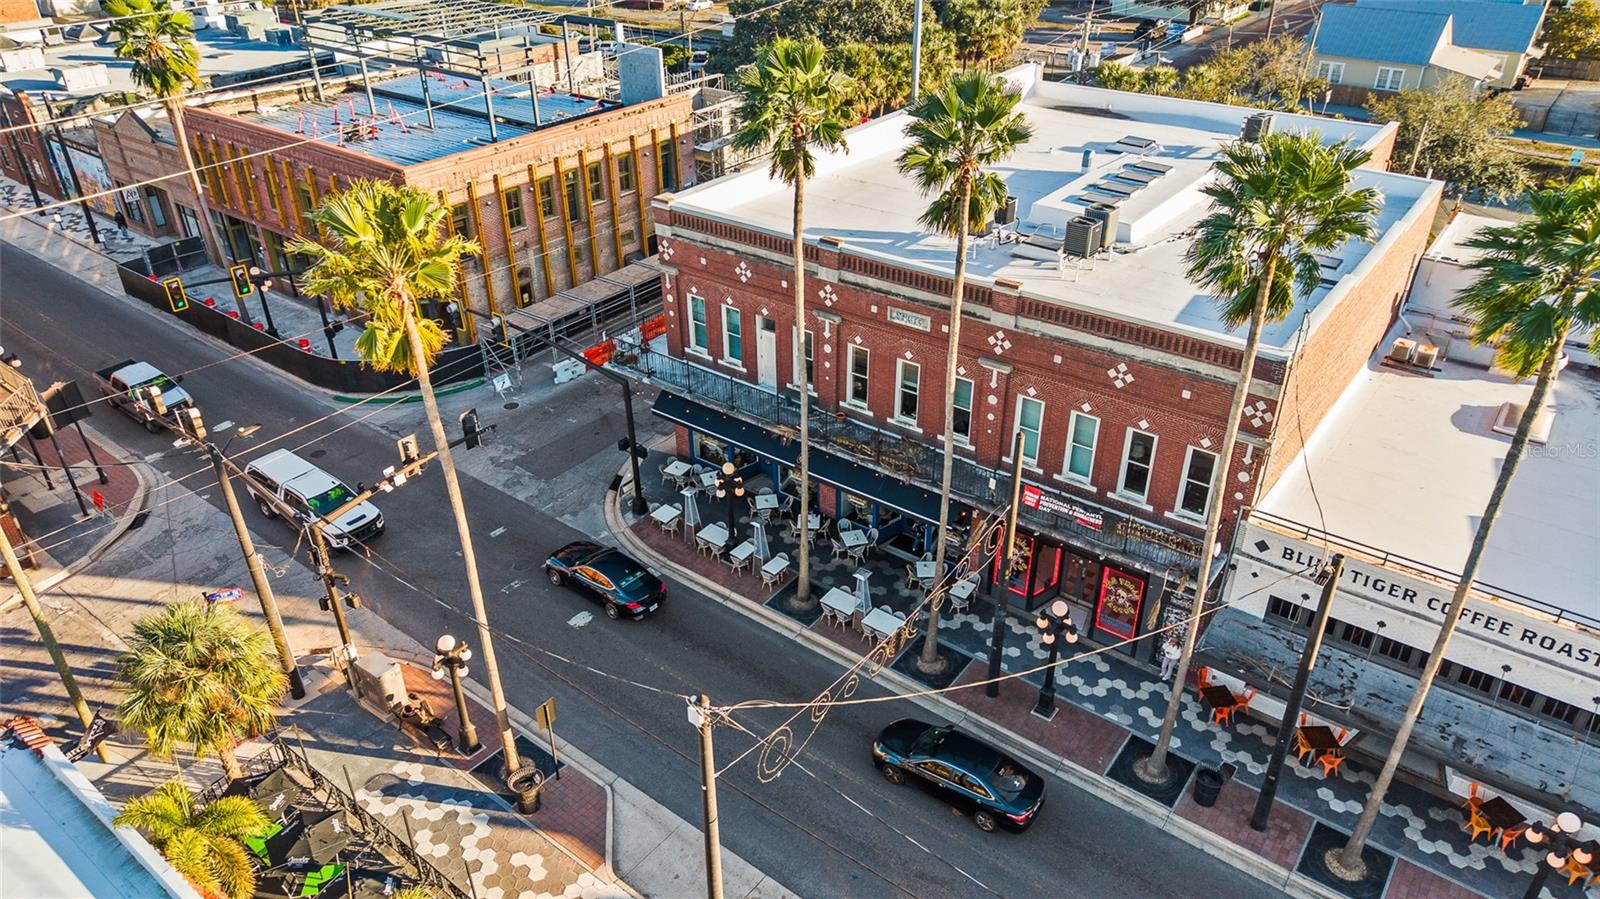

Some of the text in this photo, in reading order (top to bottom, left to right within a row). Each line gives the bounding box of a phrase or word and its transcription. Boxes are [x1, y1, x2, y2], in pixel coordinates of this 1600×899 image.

[1040, 495, 1071, 509] NATIONAL
[1281, 546, 1344, 578] BLI
[1350, 569, 1419, 604] TIGER
[1519, 628, 1600, 667] ROAST
